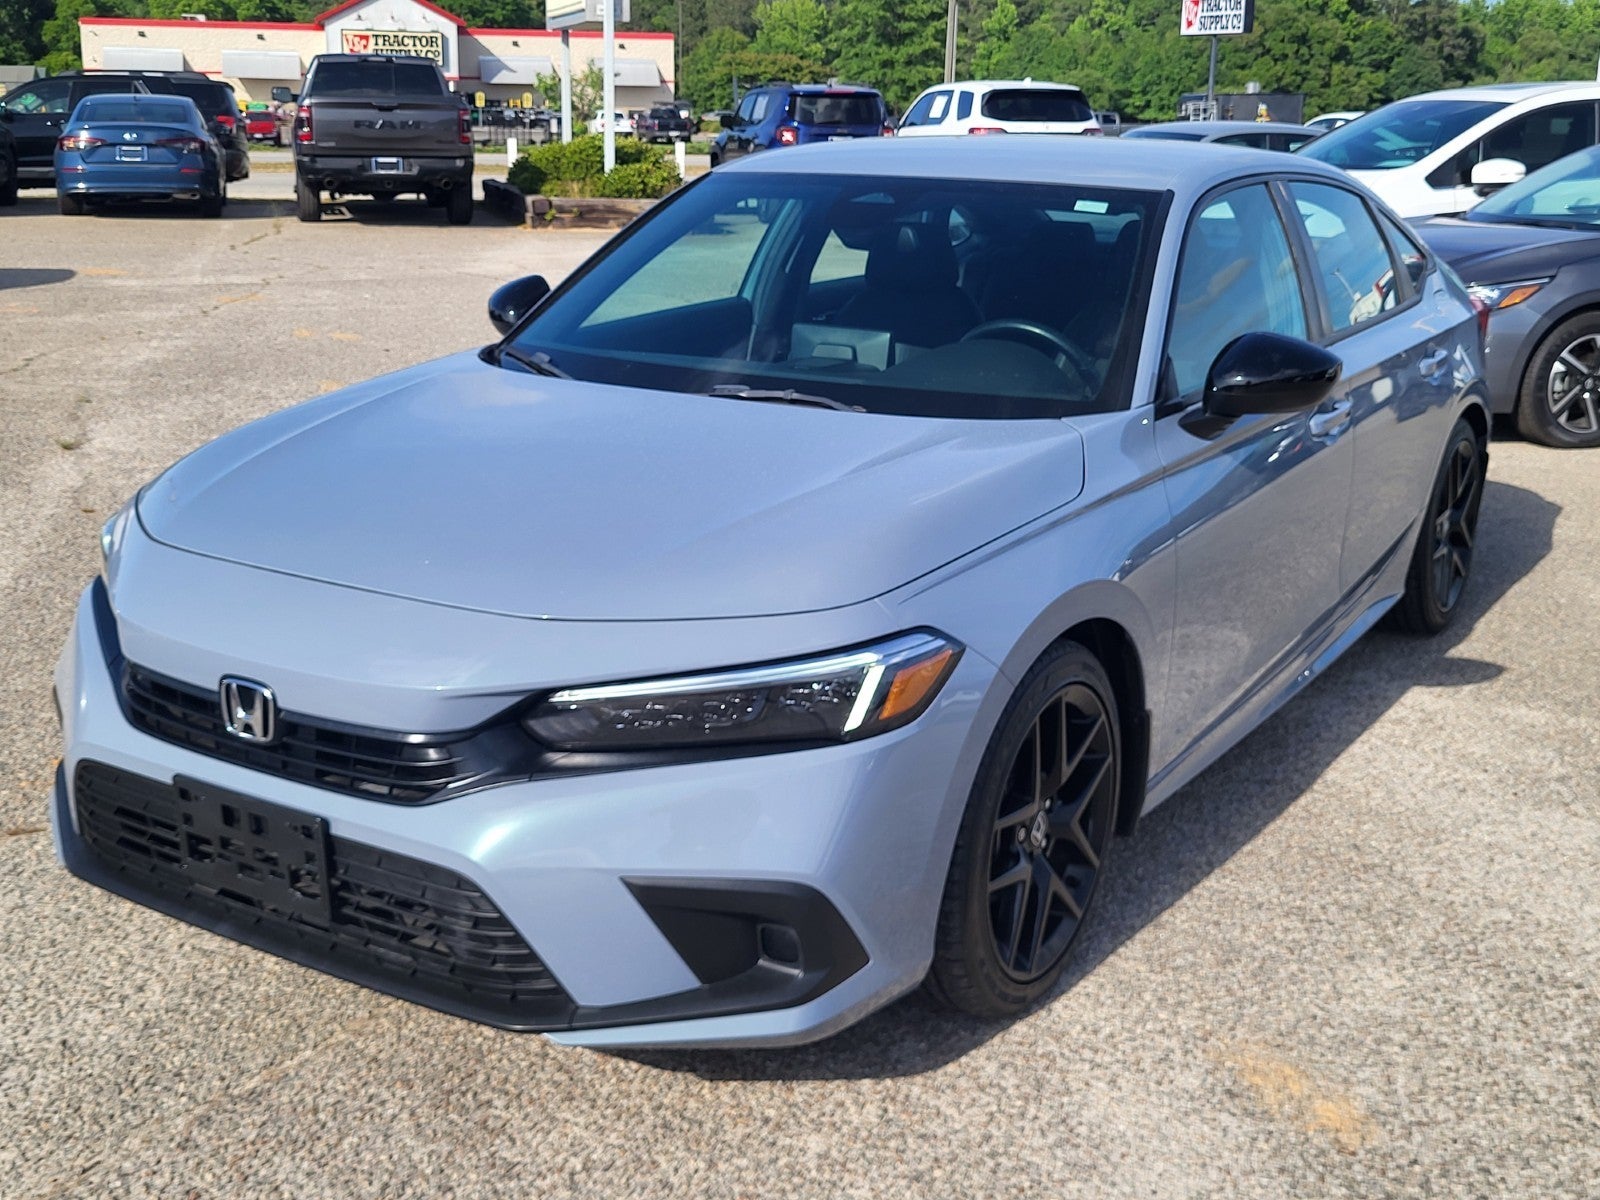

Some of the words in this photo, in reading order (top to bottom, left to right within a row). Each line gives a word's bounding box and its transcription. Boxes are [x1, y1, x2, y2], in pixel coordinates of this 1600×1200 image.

[1200, 0, 1242, 13] TRACTOR
[1198, 14, 1231, 31] SUPPLY
[372, 34, 439, 48] TRACTOR
[353, 119, 421, 130] RAM
